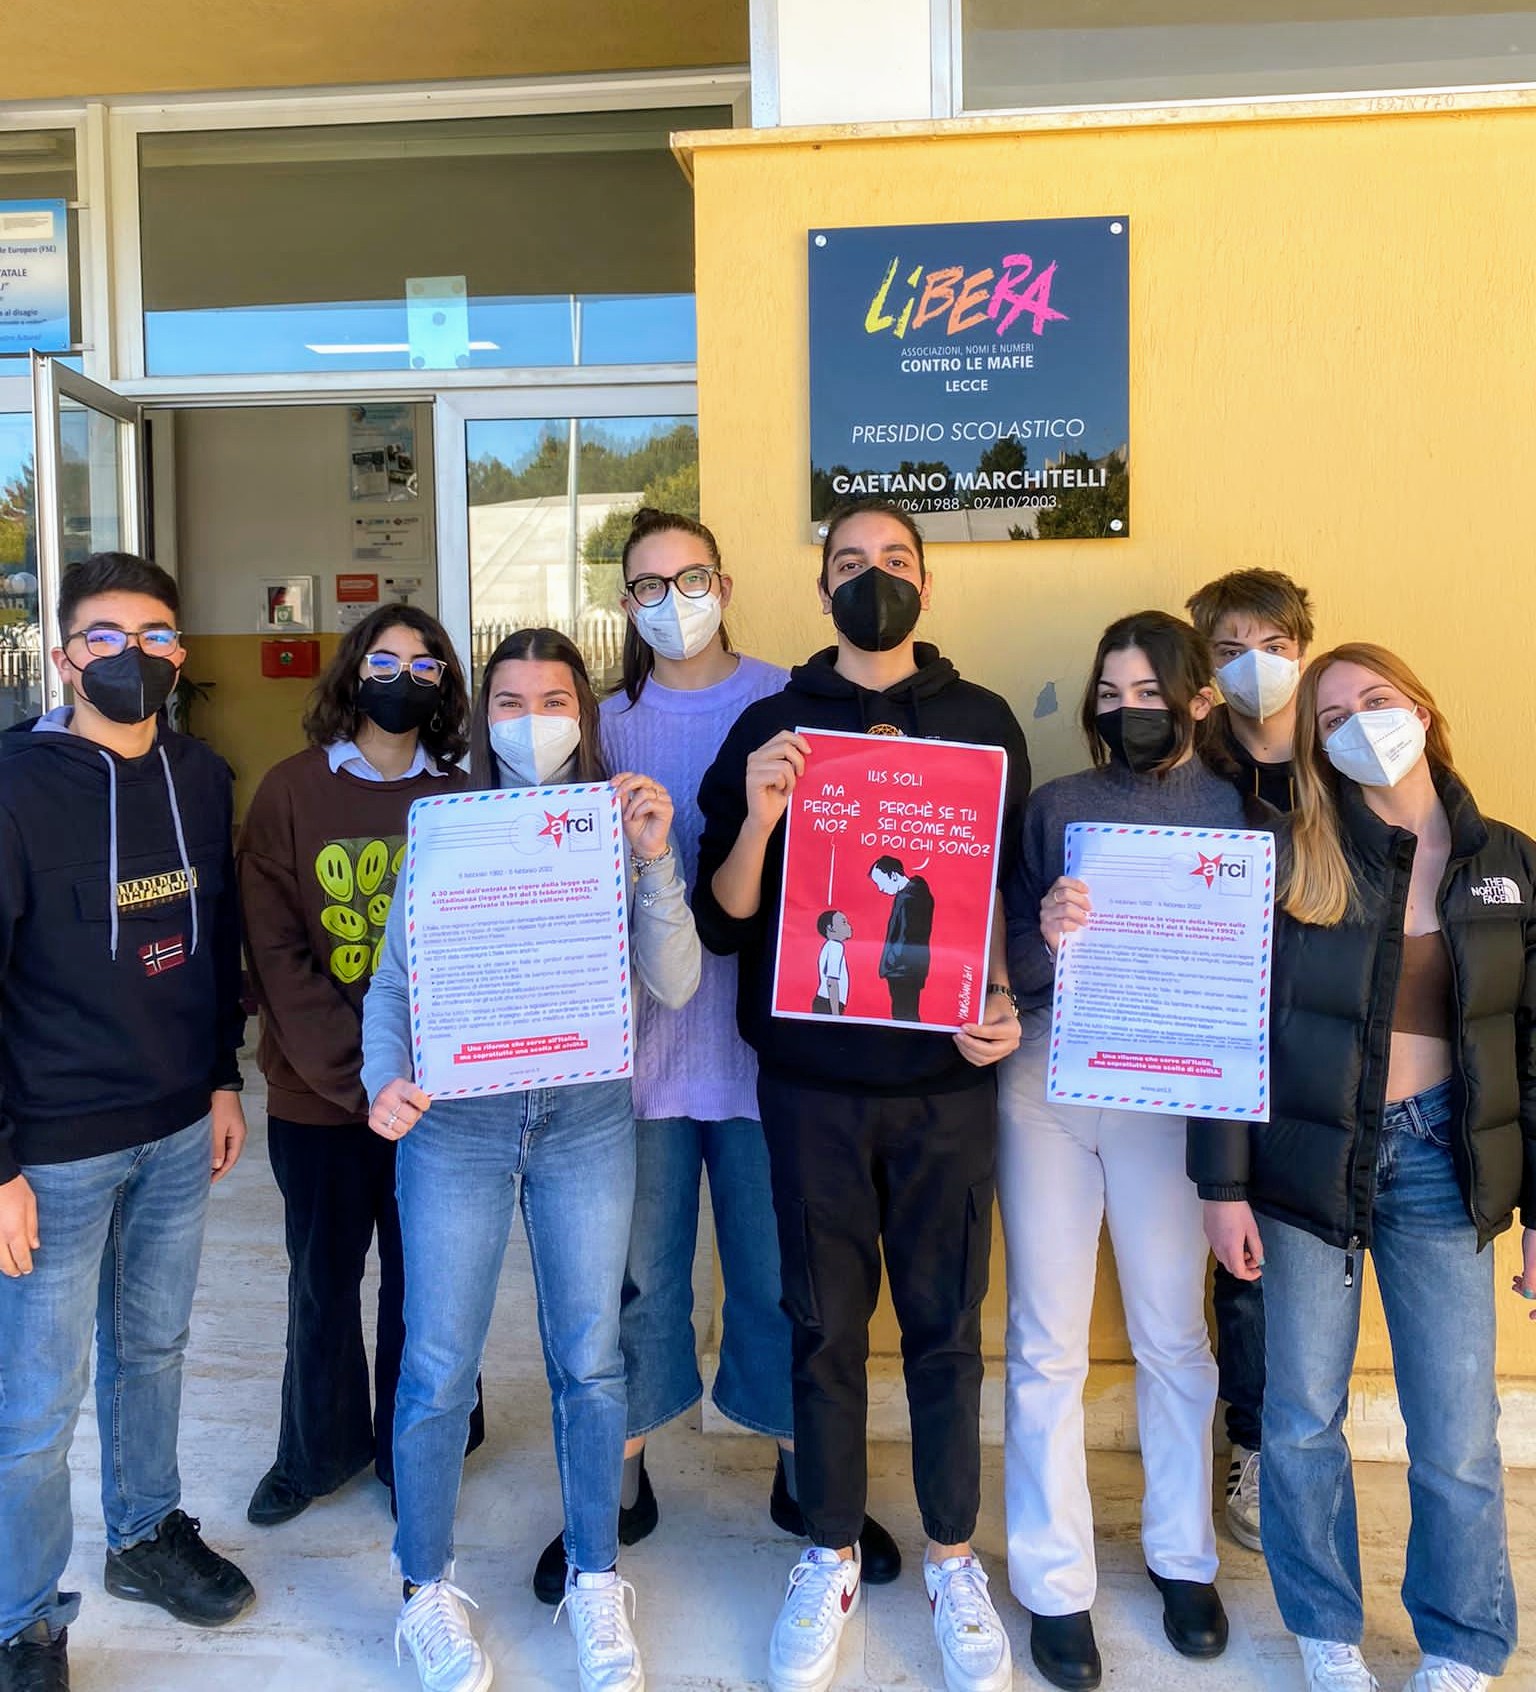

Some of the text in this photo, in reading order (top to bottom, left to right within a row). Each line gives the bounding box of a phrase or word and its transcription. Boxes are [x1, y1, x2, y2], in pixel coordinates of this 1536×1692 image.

[901, 342, 1034, 357] ASSOCIAZIONI, NOMI E NUMERI
[901, 355, 1034, 373] CONTRO LE MAFIE
[945, 379, 988, 393] LECCE
[851, 418, 1085, 444] PRESIDIO SCOLASTICO
[832, 469, 1107, 494] GAETANO MARCHITELLI
[868, 770, 923, 787] IUS SOLI
[821, 784, 845, 797] MA
[803, 799, 860, 817] PERCHÈ
[880, 800, 977, 822] PERCHÈ SE TU
[551, 813, 593, 835] arci
[813, 818, 847, 833] NO?
[878, 818, 976, 841] SEI COME ME,
[860, 833, 991, 857] IO POI CHI SONO?
[1202, 859, 1246, 879] arci
[118, 868, 198, 906] NAPAPIJ
[1483, 877, 1503, 886] THE
[1471, 886, 1505, 896] NORTH
[1483, 895, 1506, 904] FACE
